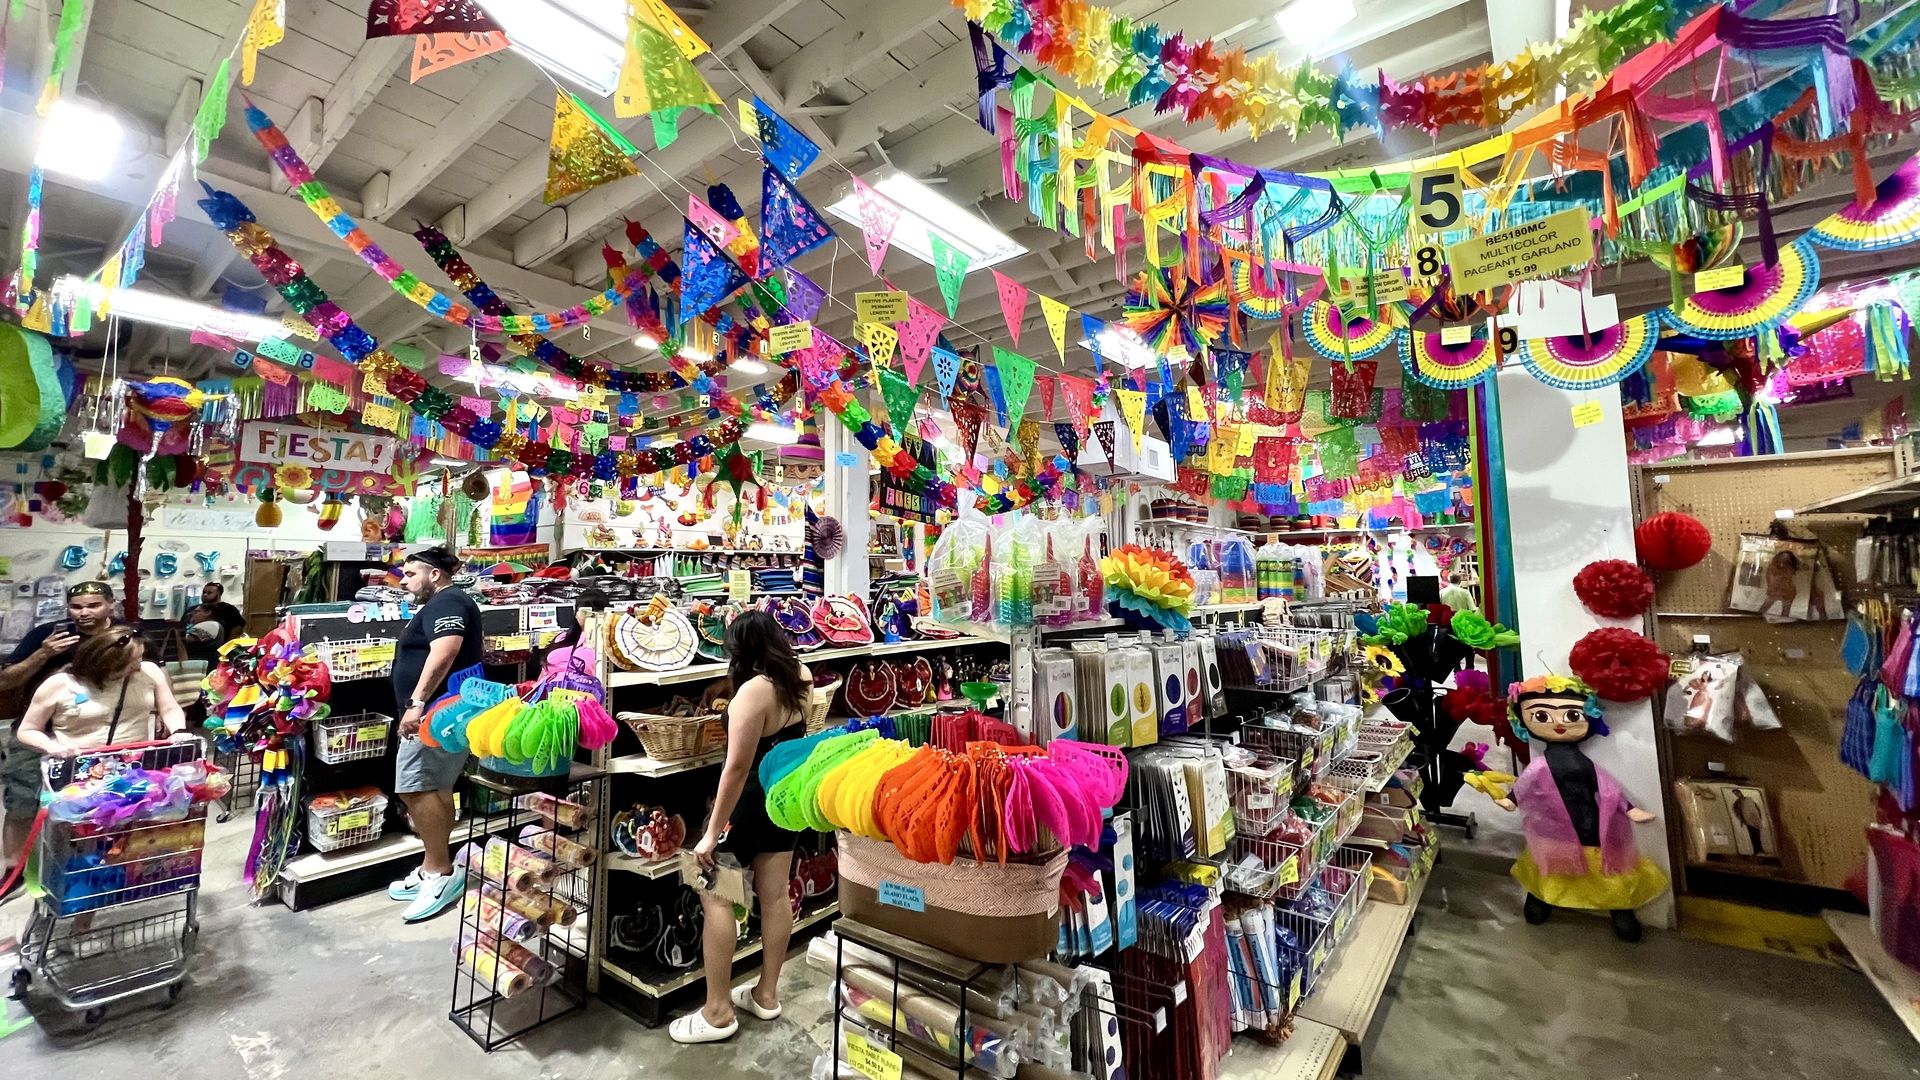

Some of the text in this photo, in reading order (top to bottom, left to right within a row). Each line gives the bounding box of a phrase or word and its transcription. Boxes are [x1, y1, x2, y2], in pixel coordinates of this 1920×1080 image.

[1420, 173, 1460, 228] 5
[1485, 221, 1547, 246] BE5180MC
[1480, 231, 1558, 261] MULTICOLOR
[1416, 246, 1440, 276] 8
[1464, 237, 1582, 278] PAGEANT GARLAND
[1507, 263, 1538, 279] $5.99
[1376, 285, 1404, 295] GARLAND
[1499, 327, 1518, 354] 9
[233, 351, 249, 366] 9
[300, 352, 314, 369] 8
[471, 350, 480, 361] 2
[586, 385, 594, 394] 6
[258, 430, 383, 466] FIESTA!
[579, 481, 589, 495] 6
[336, 738, 343, 747] 4
[329, 823, 336, 832] 7
[847, 1042, 865, 1055] FIESTA
[865, 1050, 881, 1061] TABLE
